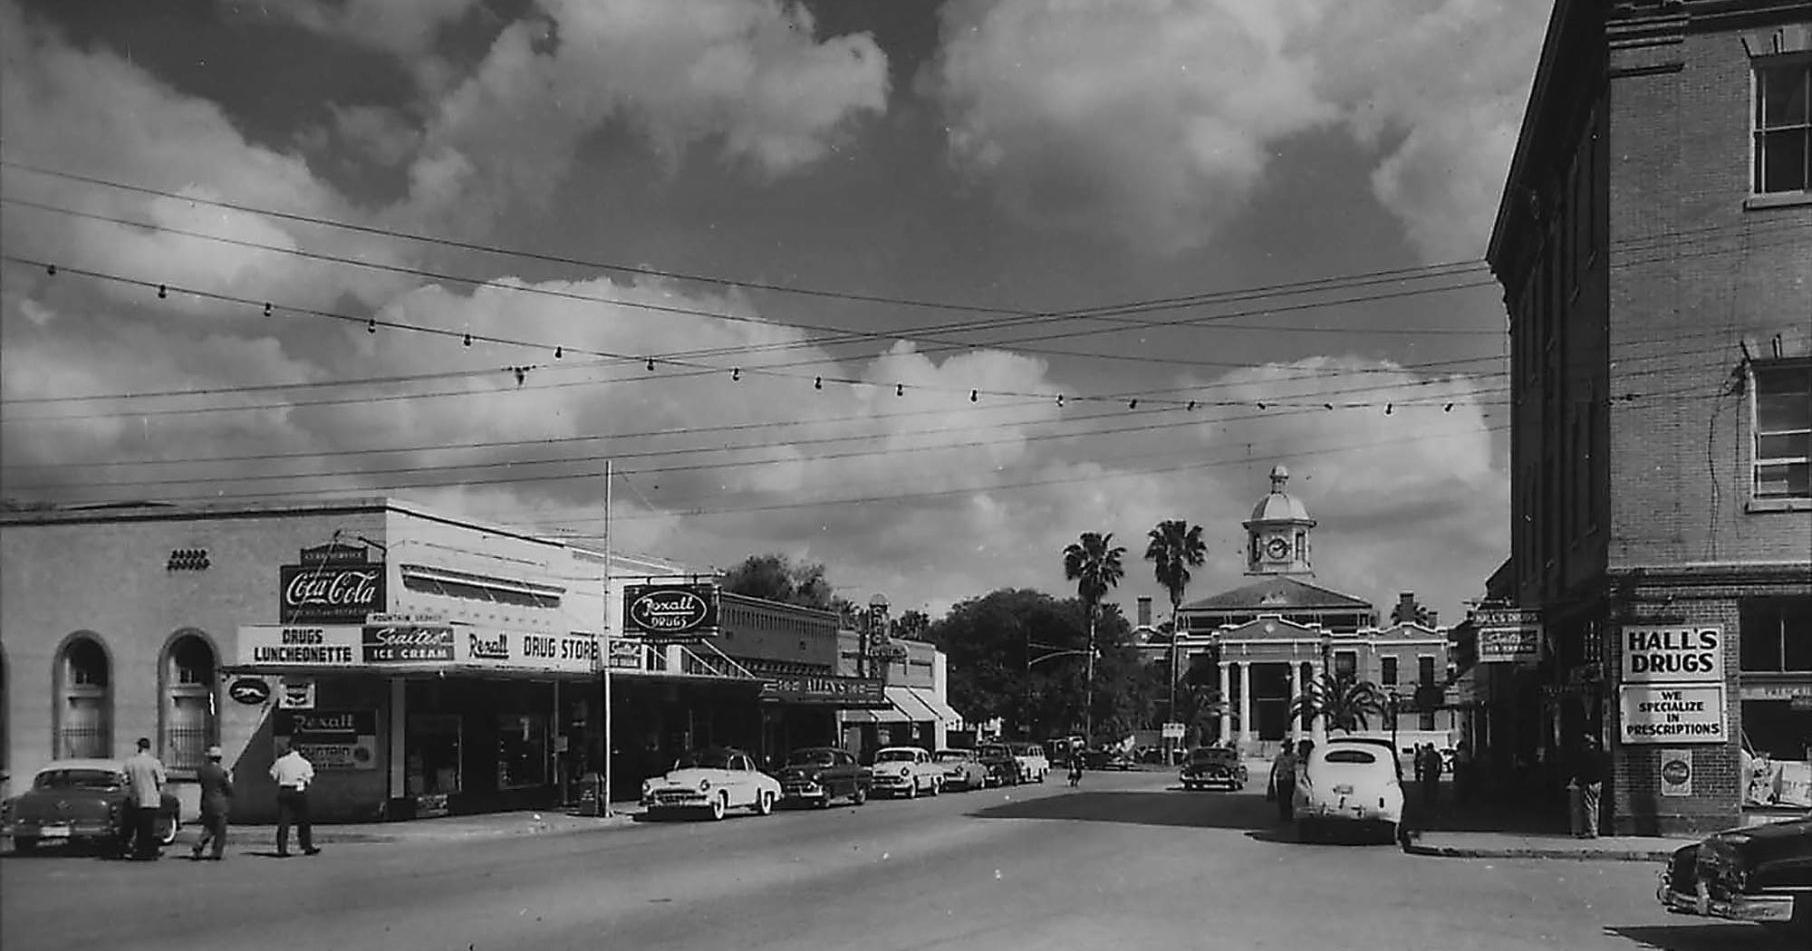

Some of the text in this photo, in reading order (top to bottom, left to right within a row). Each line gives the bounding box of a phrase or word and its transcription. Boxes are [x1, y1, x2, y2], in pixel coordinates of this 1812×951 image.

[286, 571, 379, 604] Coca-Cola
[651, 616, 687, 627] DRUGS
[282, 628, 323, 645] DRUGS
[1628, 628, 1717, 651] HALL'S
[469, 632, 509, 659] Rexall
[523, 635, 598, 661] DRUG STORE
[254, 646, 352, 662] LUNCHEONETTE
[374, 649, 447, 659] ICE CREAM
[1631, 653, 1714, 673] DRUGS
[1661, 691, 1682, 701] WE
[1638, 701, 1705, 712] SPECIALIZE
[1667, 713, 1680, 722] IN
[1626, 722, 1720, 736] PRESCRIPTIONS
